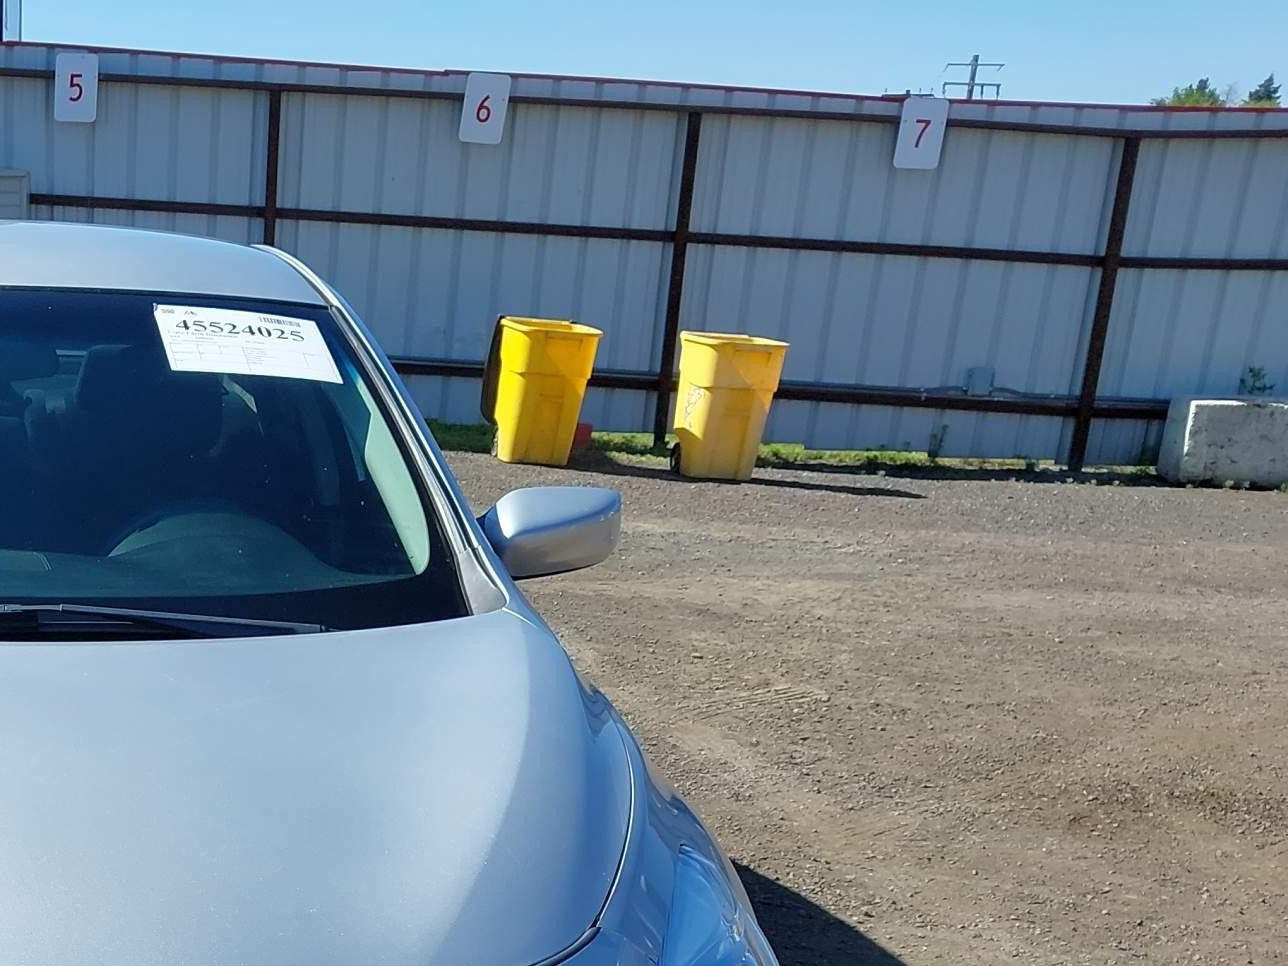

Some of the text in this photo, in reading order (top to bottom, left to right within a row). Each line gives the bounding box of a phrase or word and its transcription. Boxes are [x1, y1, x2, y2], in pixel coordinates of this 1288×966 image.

[69, 73, 84, 102] 5
[475, 96, 491, 122] 6
[915, 119, 931, 148] 7
[175, 319, 305, 342] 45524025
